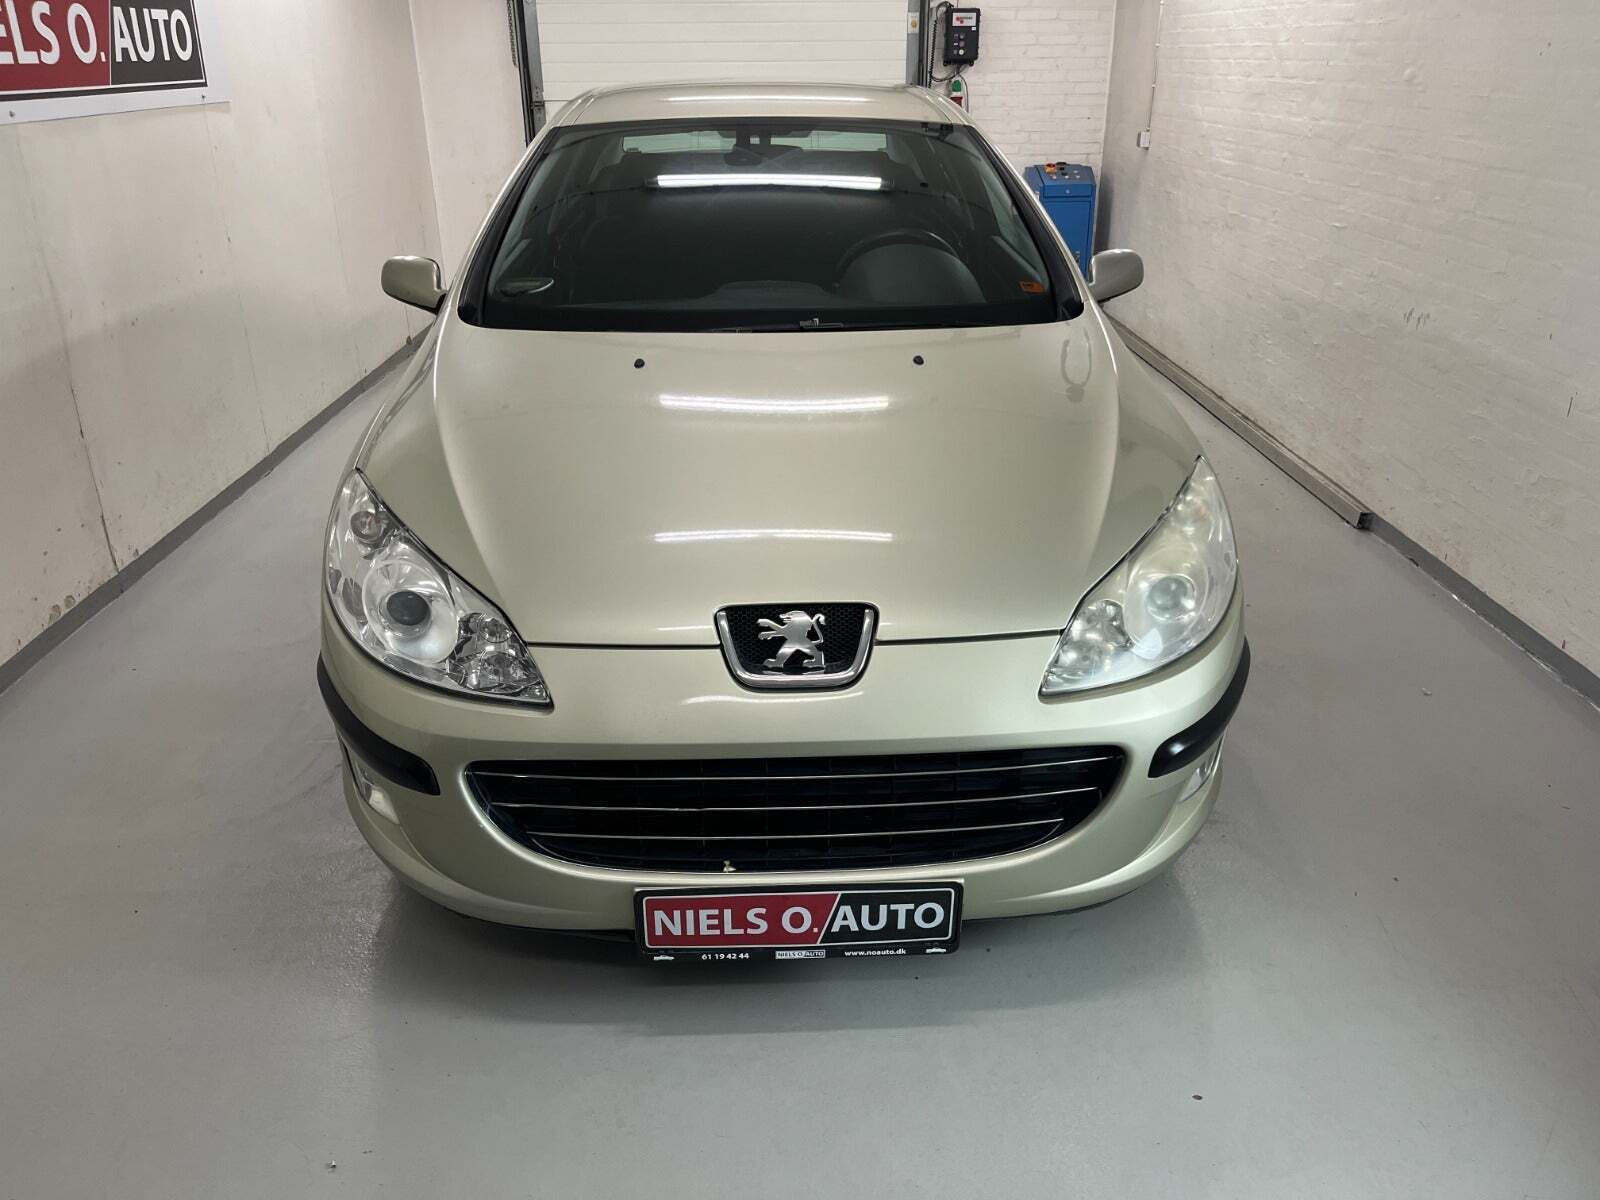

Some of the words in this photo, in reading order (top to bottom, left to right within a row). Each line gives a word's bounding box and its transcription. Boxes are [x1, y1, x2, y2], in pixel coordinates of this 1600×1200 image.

[67, 3, 107, 64] O.
[112, 6, 193, 63] AUTO
[653, 906, 769, 936] NIELS
[781, 905, 819, 934] O.
[830, 901, 945, 933] AUTO
[738, 952, 750, 960] 44
